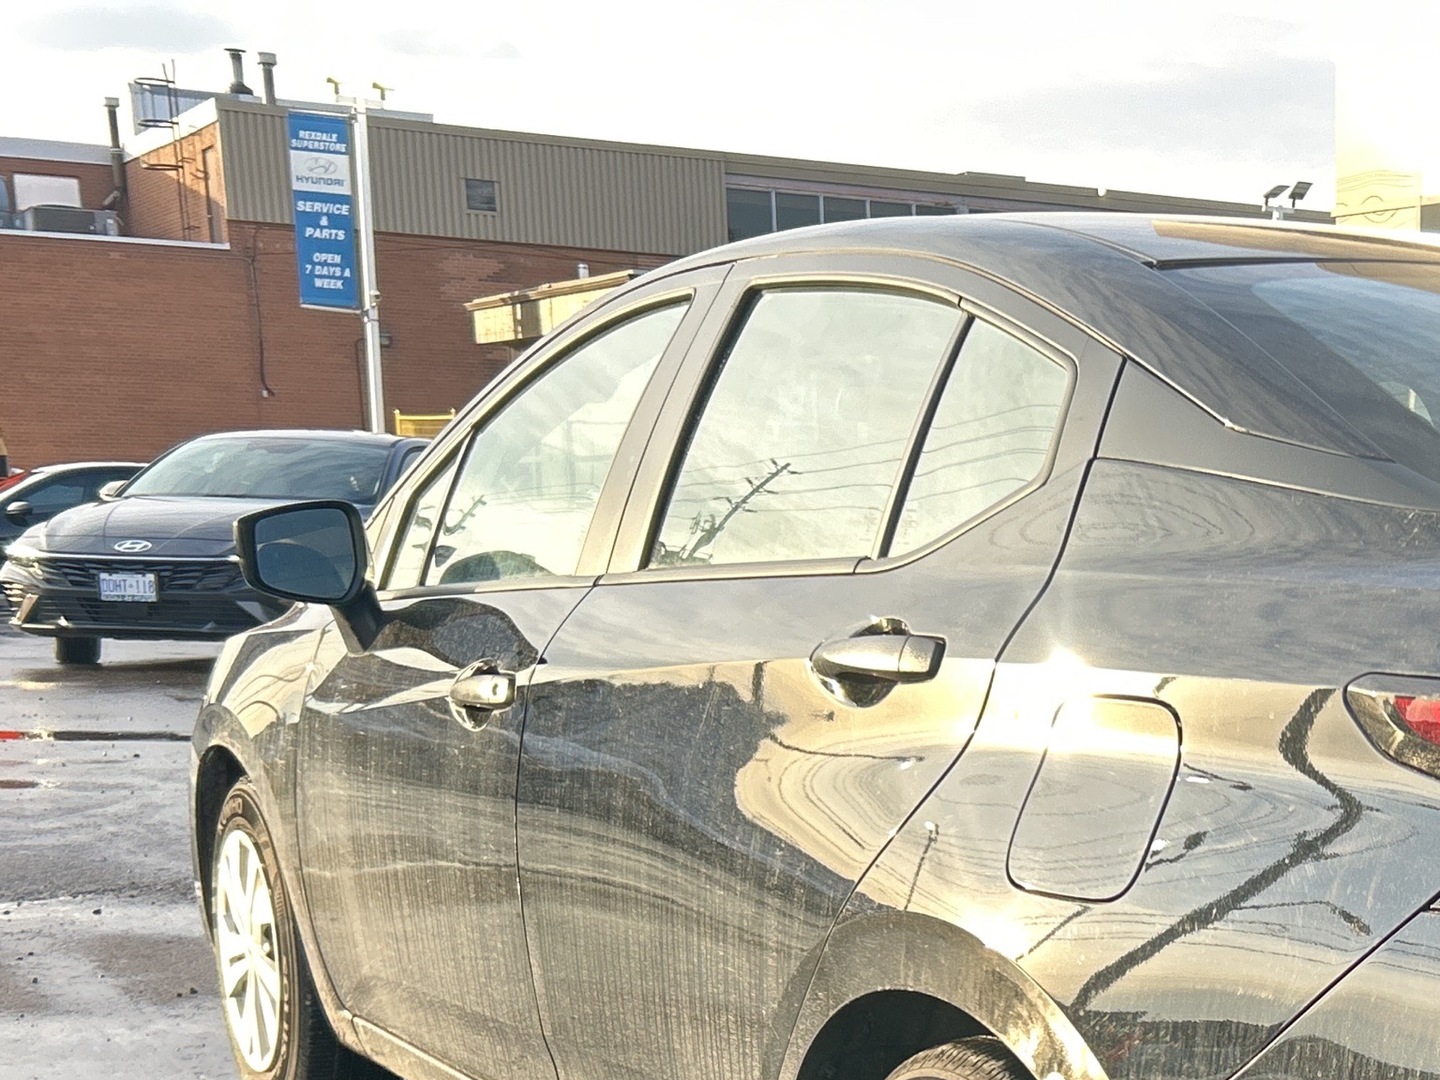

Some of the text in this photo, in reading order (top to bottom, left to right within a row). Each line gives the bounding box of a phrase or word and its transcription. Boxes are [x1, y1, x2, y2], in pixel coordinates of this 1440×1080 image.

[298, 130, 338, 142] REXDALE
[291, 138, 347, 152] SUPERSTORE
[295, 175, 346, 187] HYUNDAI
[296, 200, 351, 215] SERVICE
[319, 215, 329, 226] &
[305, 227, 346, 240] PARTS
[313, 252, 342, 264] OPEN
[305, 264, 351, 278] 7 DAYS A
[314, 277, 344, 289] WEEK
